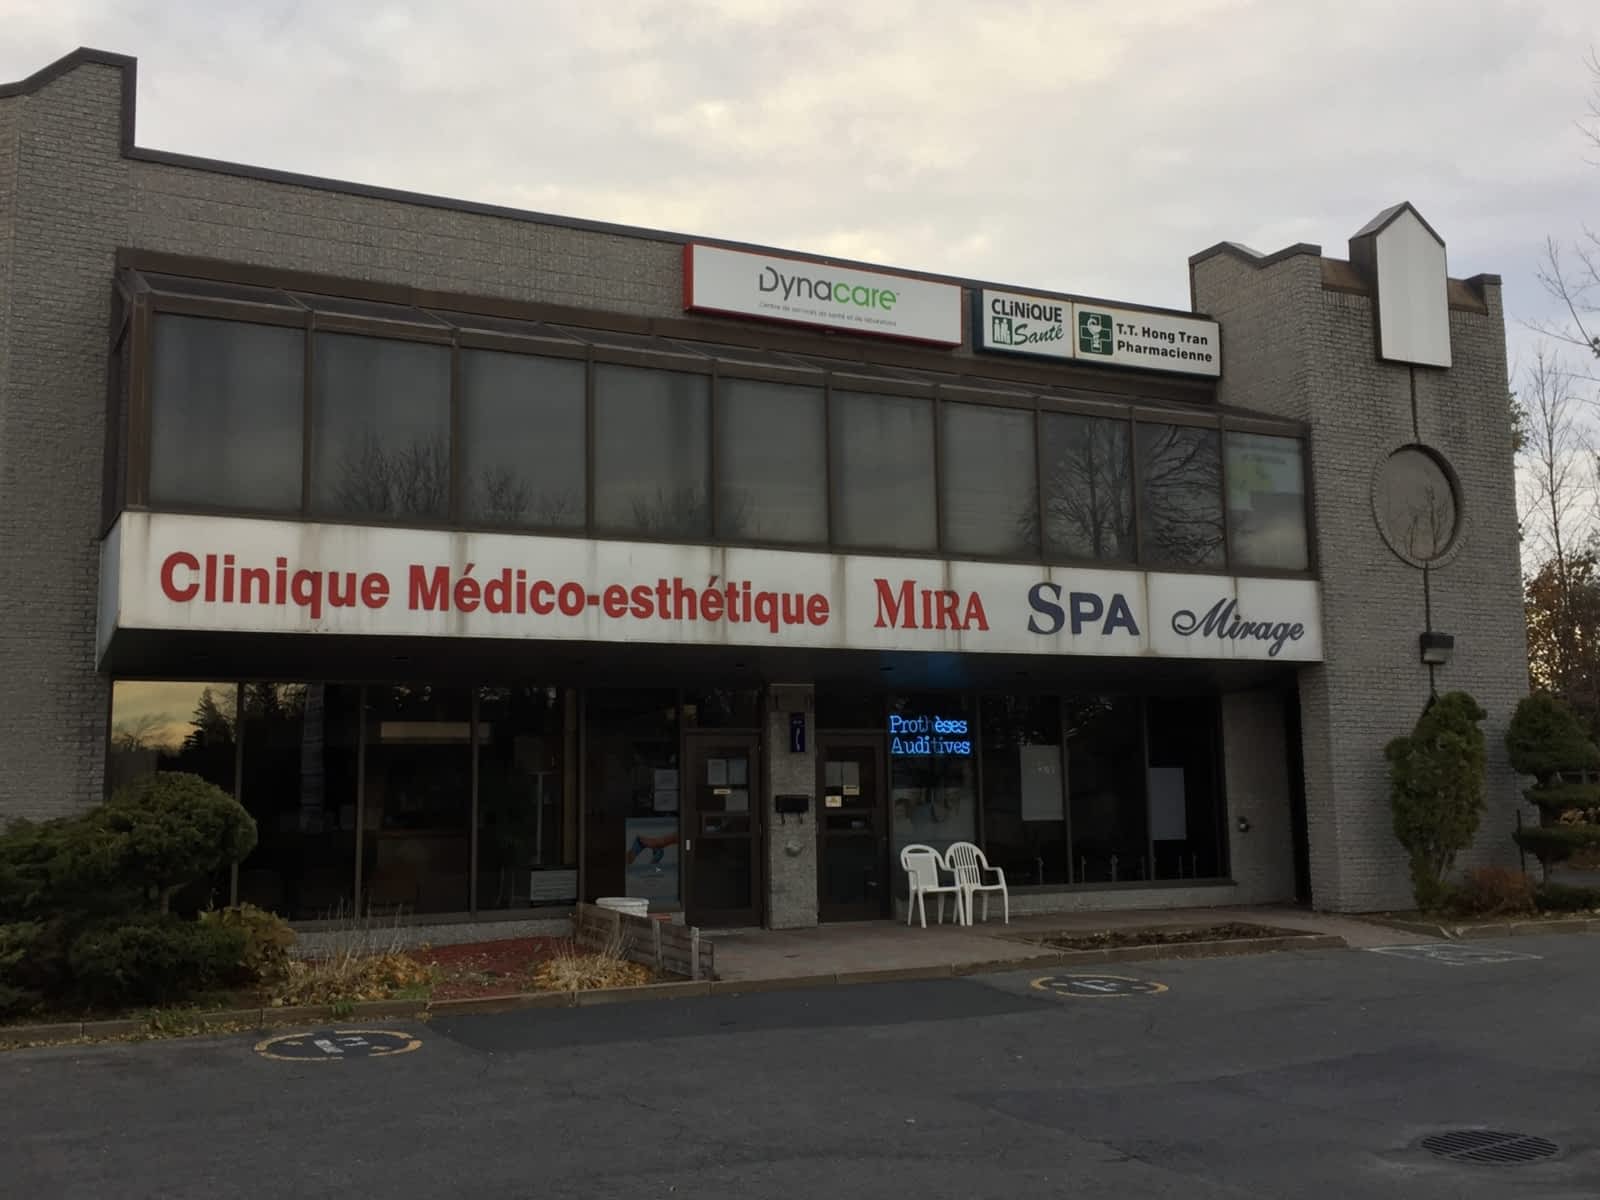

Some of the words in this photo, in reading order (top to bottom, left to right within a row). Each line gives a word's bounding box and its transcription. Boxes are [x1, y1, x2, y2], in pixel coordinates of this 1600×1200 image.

[759, 266, 897, 310] Dynacare
[1014, 323, 1064, 346] Santé
[1116, 323, 1138, 336] T.T.
[1141, 326, 1175, 344] Hong
[1178, 331, 1208, 345] Tran
[1117, 340, 1213, 362] Pharmacienne
[160, 551, 390, 619] Clinique
[408, 562, 831, 633] Médico-esthétique
[1027, 582, 1140, 636] SPA
[1171, 598, 1305, 657] Mirage
[891, 736, 970, 755] Auditives
